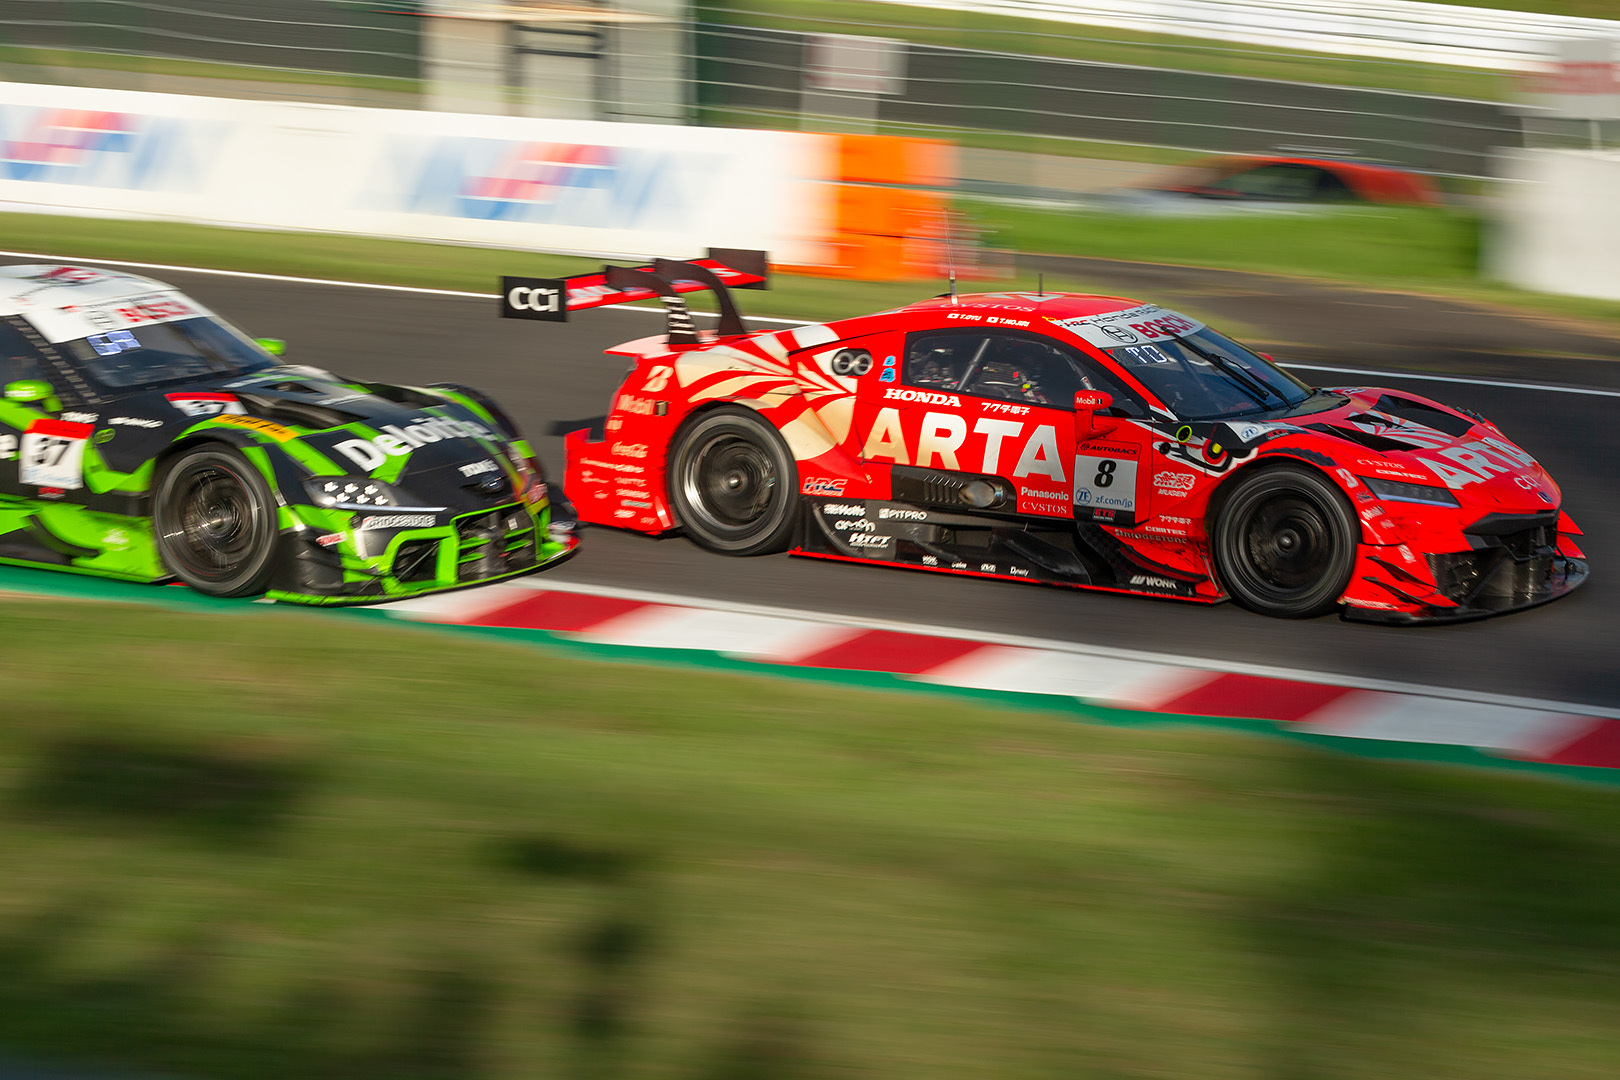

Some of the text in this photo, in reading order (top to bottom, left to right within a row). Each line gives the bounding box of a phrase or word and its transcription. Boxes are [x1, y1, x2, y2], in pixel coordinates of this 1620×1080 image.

[1128, 313, 1196, 339] BOSCH
[884, 389, 961, 408] HONDA
[1076, 396, 1095, 405] Mobil
[331, 415, 498, 473] Deloitte
[857, 407, 1067, 483] ARTA
[1089, 445, 1138, 455] AUTOBACS
[1415, 433, 1534, 490] ARTA
[1093, 460, 1117, 488] 8
[1021, 486, 1070, 501] Panasonic
[1022, 502, 1067, 514] CVSTOS
[1095, 495, 1133, 509] zf.com/jp
[889, 509, 928, 520] PITPRO
[1114, 529, 1187, 544] BRIDGESTONE
[1145, 526, 1187, 536] COMTEC
[1145, 576, 1178, 590] WORK
